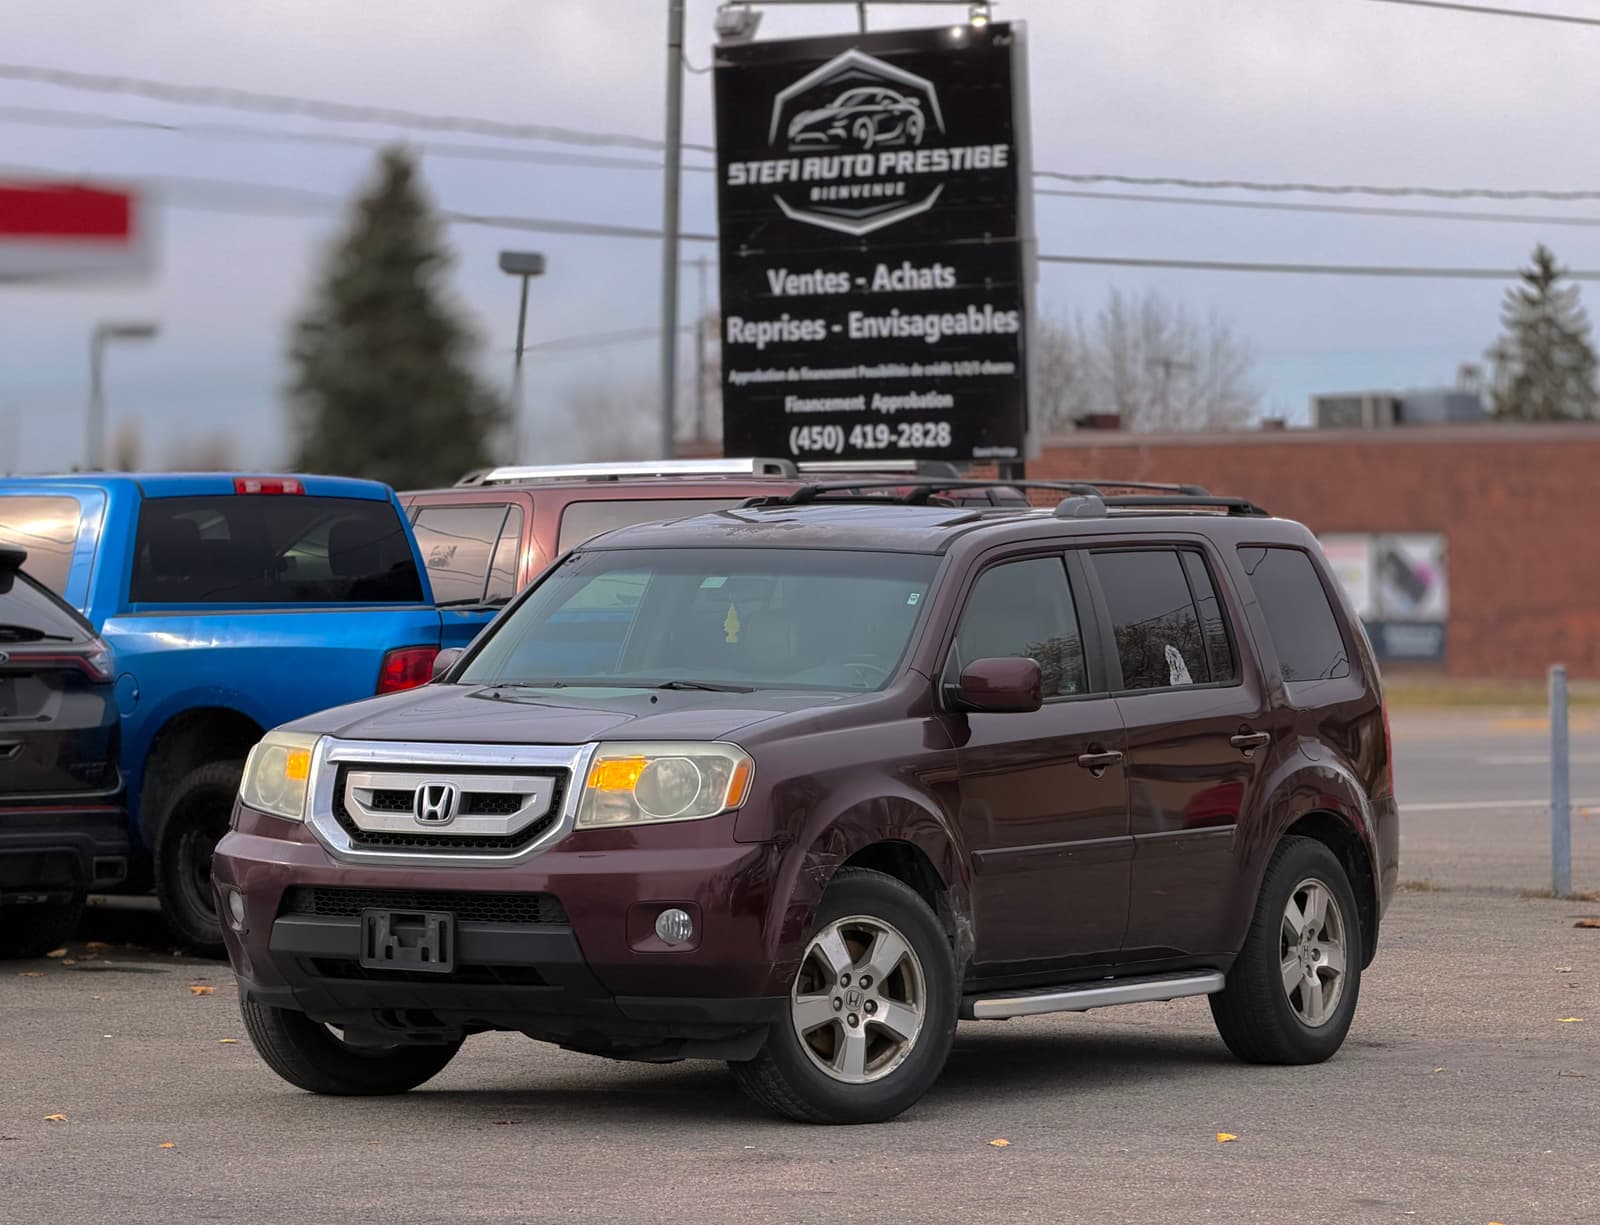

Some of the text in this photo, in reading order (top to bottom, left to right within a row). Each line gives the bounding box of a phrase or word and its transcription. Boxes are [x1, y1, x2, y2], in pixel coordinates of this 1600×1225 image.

[728, 144, 1008, 185] STEFI AUTO PRESTIGE
[811, 182, 904, 200] BIENVENUE
[767, 269, 850, 295] Ventes
[872, 262, 956, 291] Achats
[727, 314, 826, 349] Reprises
[849, 304, 1019, 343] Envisageables
[785, 391, 953, 413] Financement Approbation
[790, 422, 951, 454] (450) 419-2828
